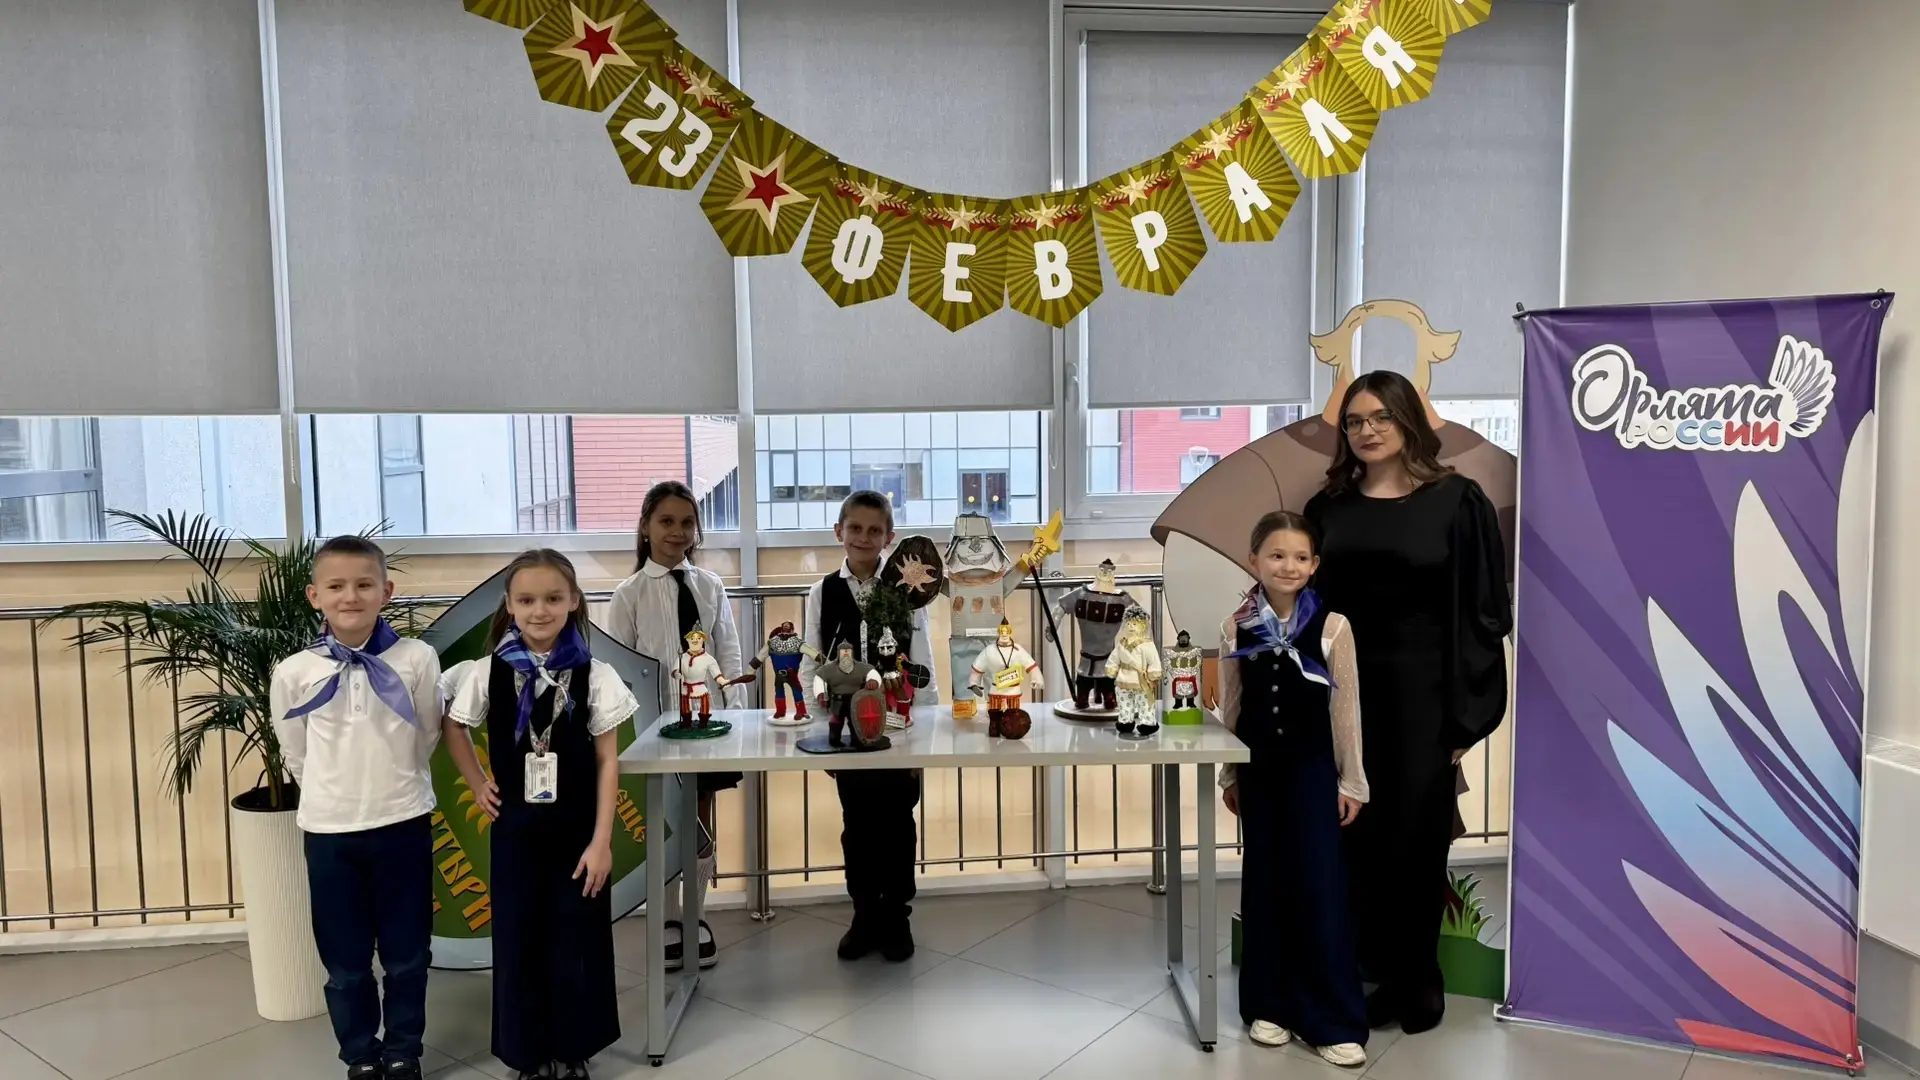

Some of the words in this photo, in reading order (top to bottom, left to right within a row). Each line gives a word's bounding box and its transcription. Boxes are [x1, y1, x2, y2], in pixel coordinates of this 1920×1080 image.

[620, 80, 713, 178] 23
[829, 25, 1417, 304] ФЕВРАЛЯ
[1577, 348, 1784, 434] Орлята
[1626, 419, 1780, 448] РОССИИ
